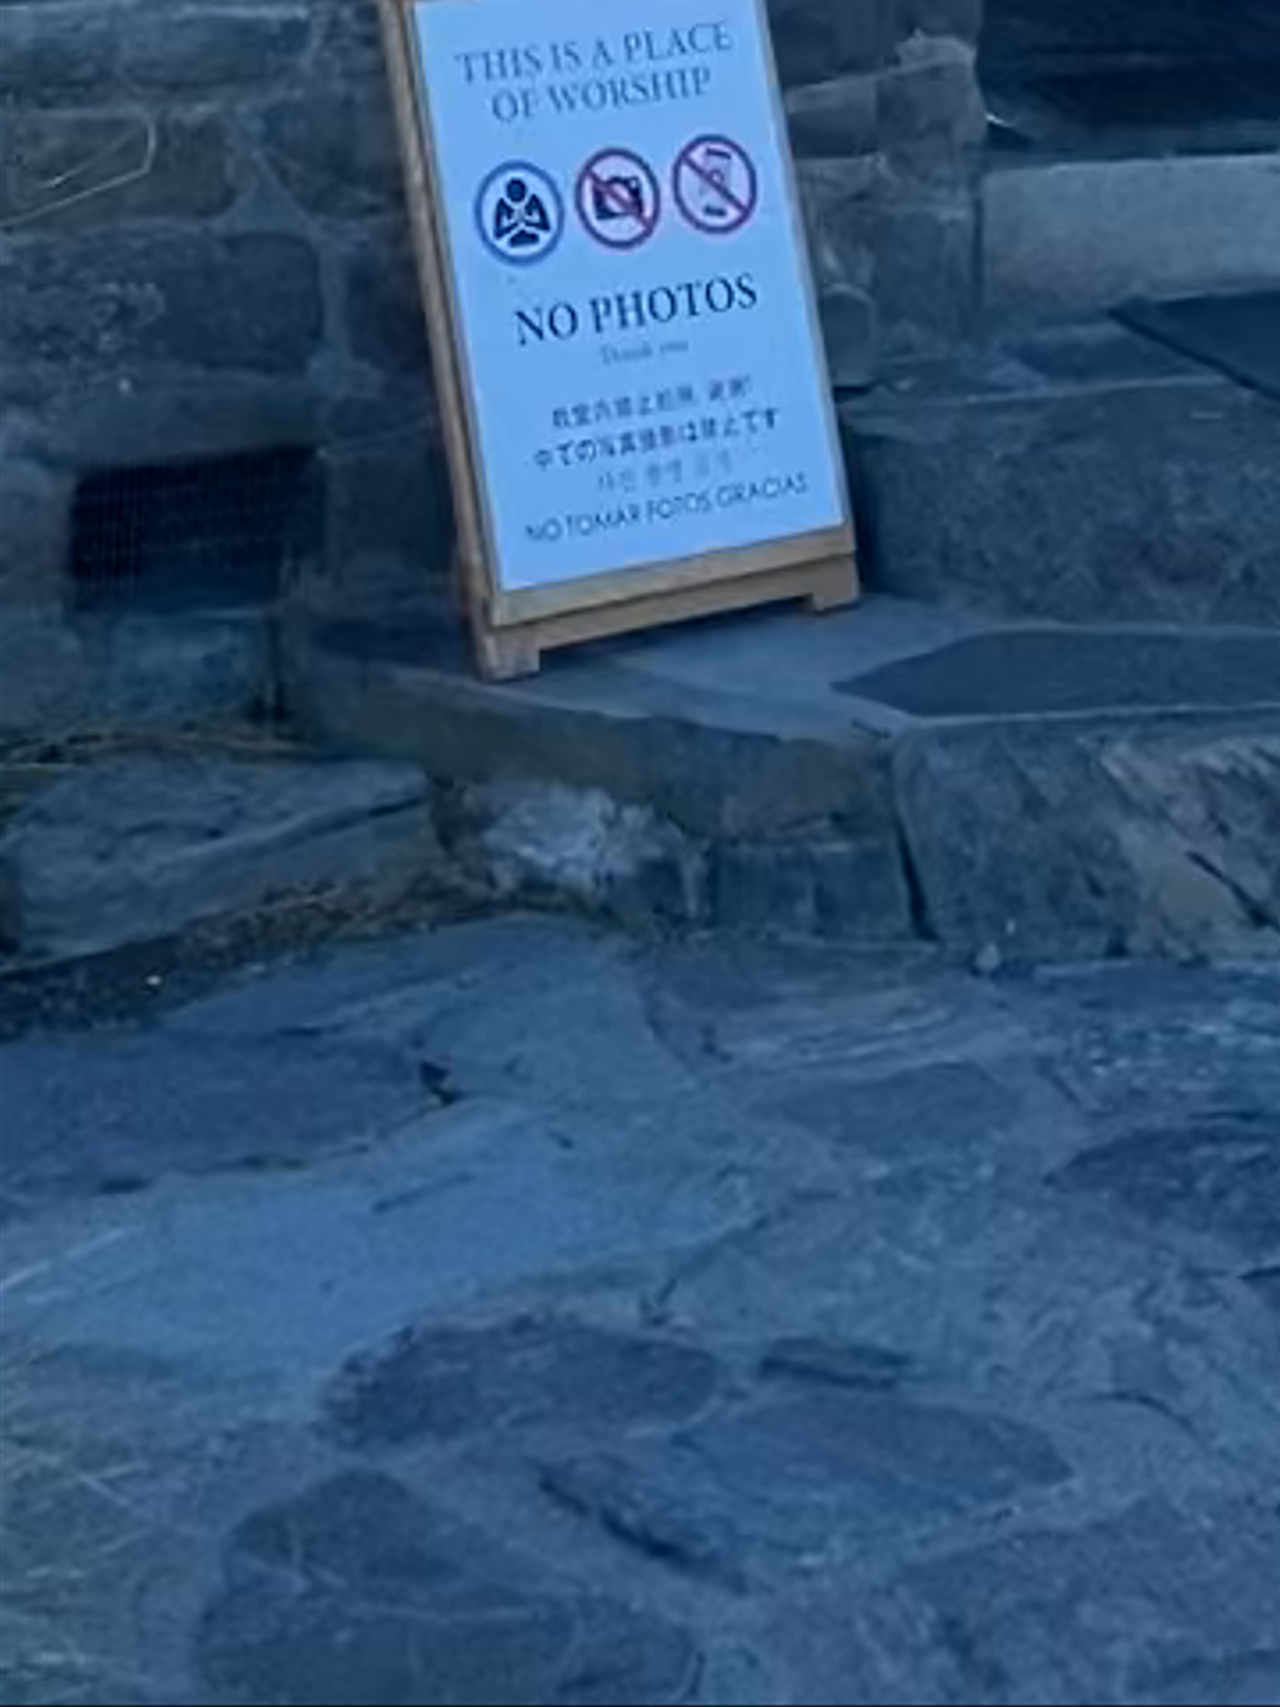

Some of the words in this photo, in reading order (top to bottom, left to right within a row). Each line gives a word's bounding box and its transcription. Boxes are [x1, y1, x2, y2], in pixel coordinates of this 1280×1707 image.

[453, 42, 542, 85] THIS
[550, 40, 583, 72] IS
[592, 37, 615, 69] A
[623, 20, 733, 64] PLACE
[491, 88, 541, 123] OF
[548, 66, 711, 114] WORSHIP
[514, 302, 578, 346] NO
[590, 272, 758, 333] PHOTOS
[523, 517, 563, 541] NO
[566, 502, 641, 536] TOMAR
[649, 489, 711, 523] FOTOS
[715, 471, 808, 508] GRACIAS
